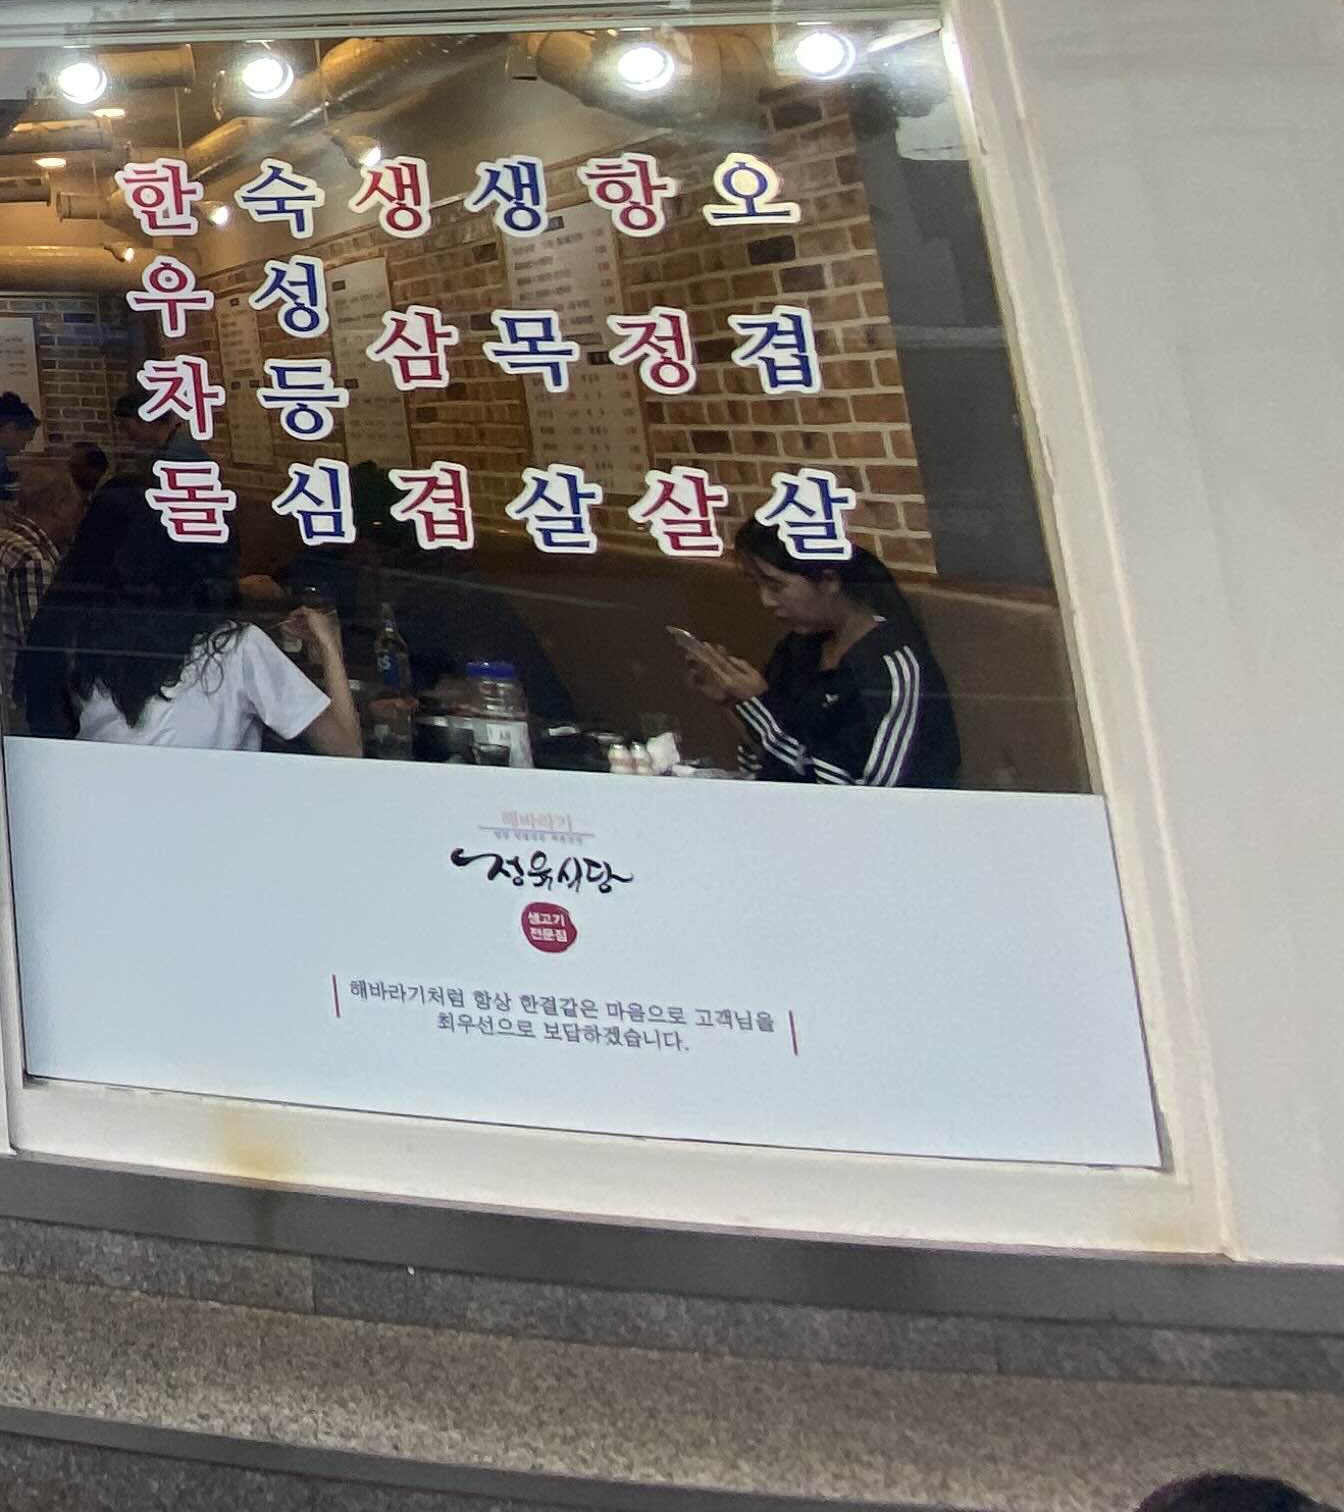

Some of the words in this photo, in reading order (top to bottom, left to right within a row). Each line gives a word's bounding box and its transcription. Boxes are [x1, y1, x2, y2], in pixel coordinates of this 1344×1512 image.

[451, 848, 634, 893] 정육식당
[350, 979, 464, 1009] 해바라기처럼
[473, 988, 512, 1013] 항상
[519, 993, 600, 1020] 한결같은
[607, 1000, 687, 1027] 마음으로
[695, 1007, 775, 1033] 고객님을
[437, 1011, 537, 1040] 최우선으로
[544, 1021, 690, 1052] 보답하겠습니다.
